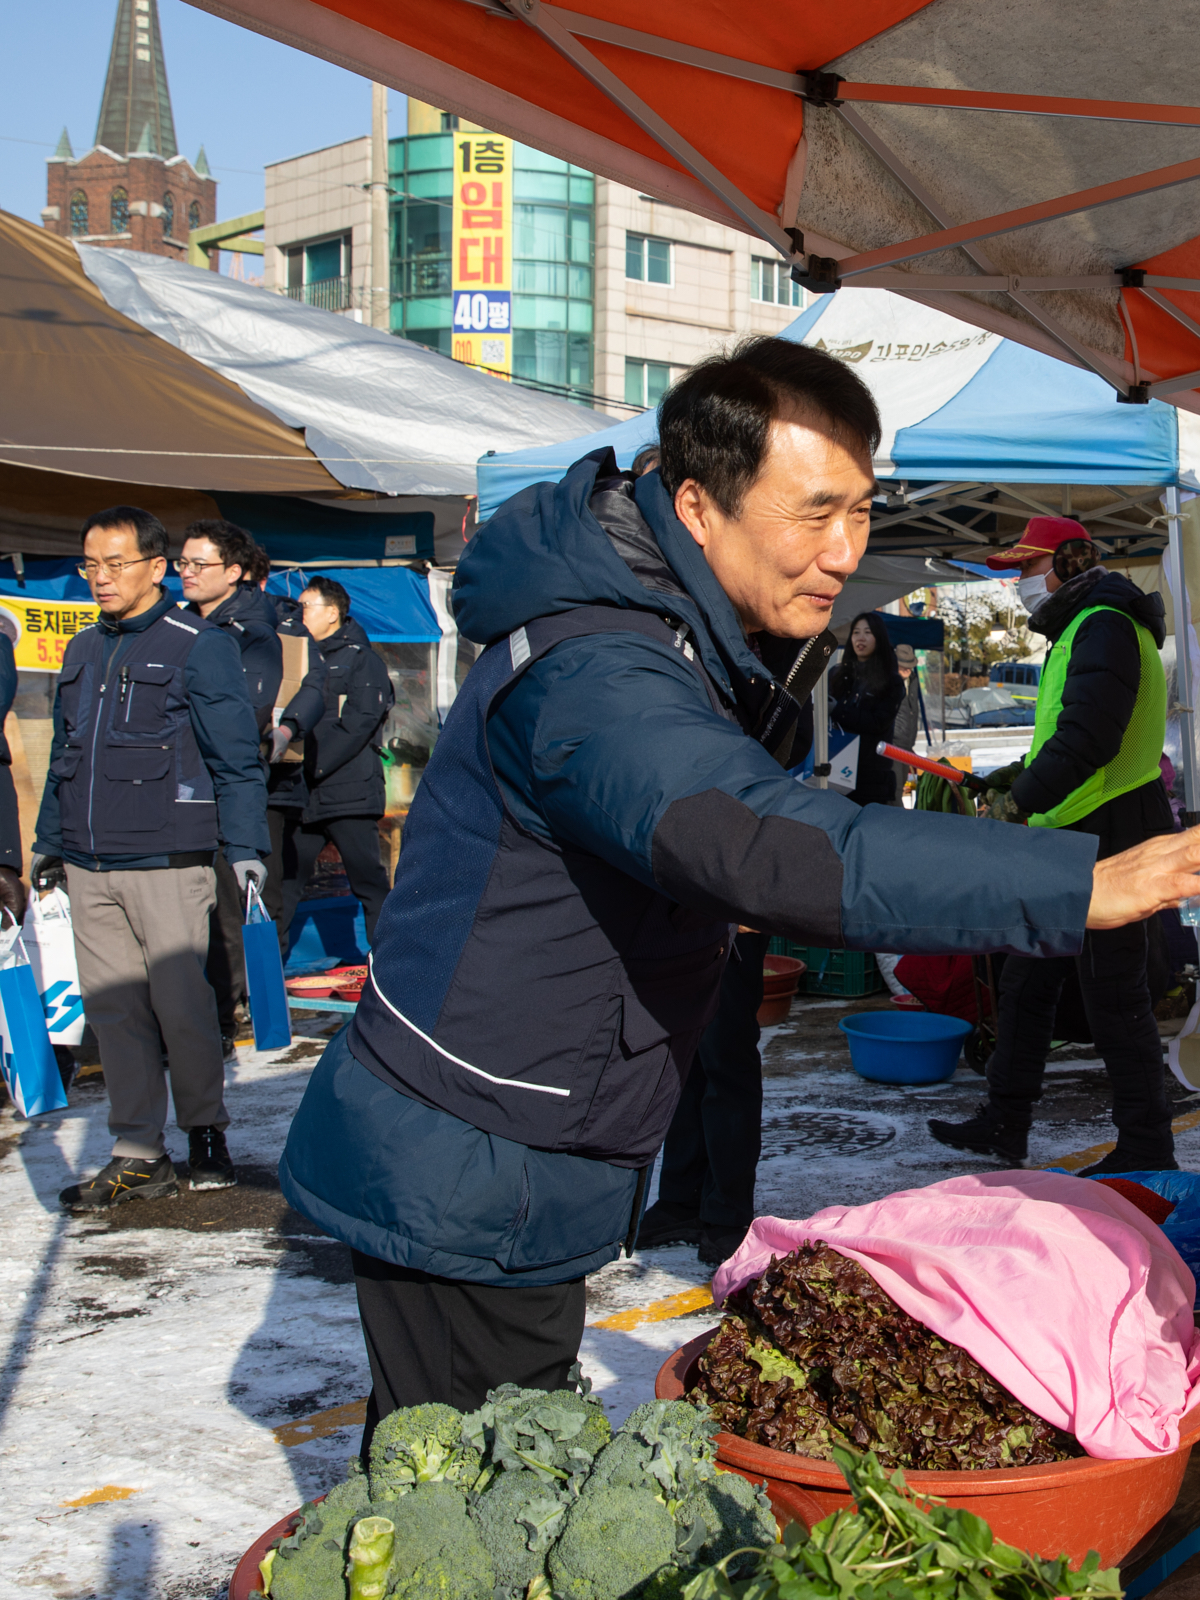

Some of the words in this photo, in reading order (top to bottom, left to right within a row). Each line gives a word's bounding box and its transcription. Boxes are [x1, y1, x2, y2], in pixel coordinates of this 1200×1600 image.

[459, 141, 504, 173] 1층
[460, 182, 503, 284] 임대
[454, 294, 509, 330] 40평
